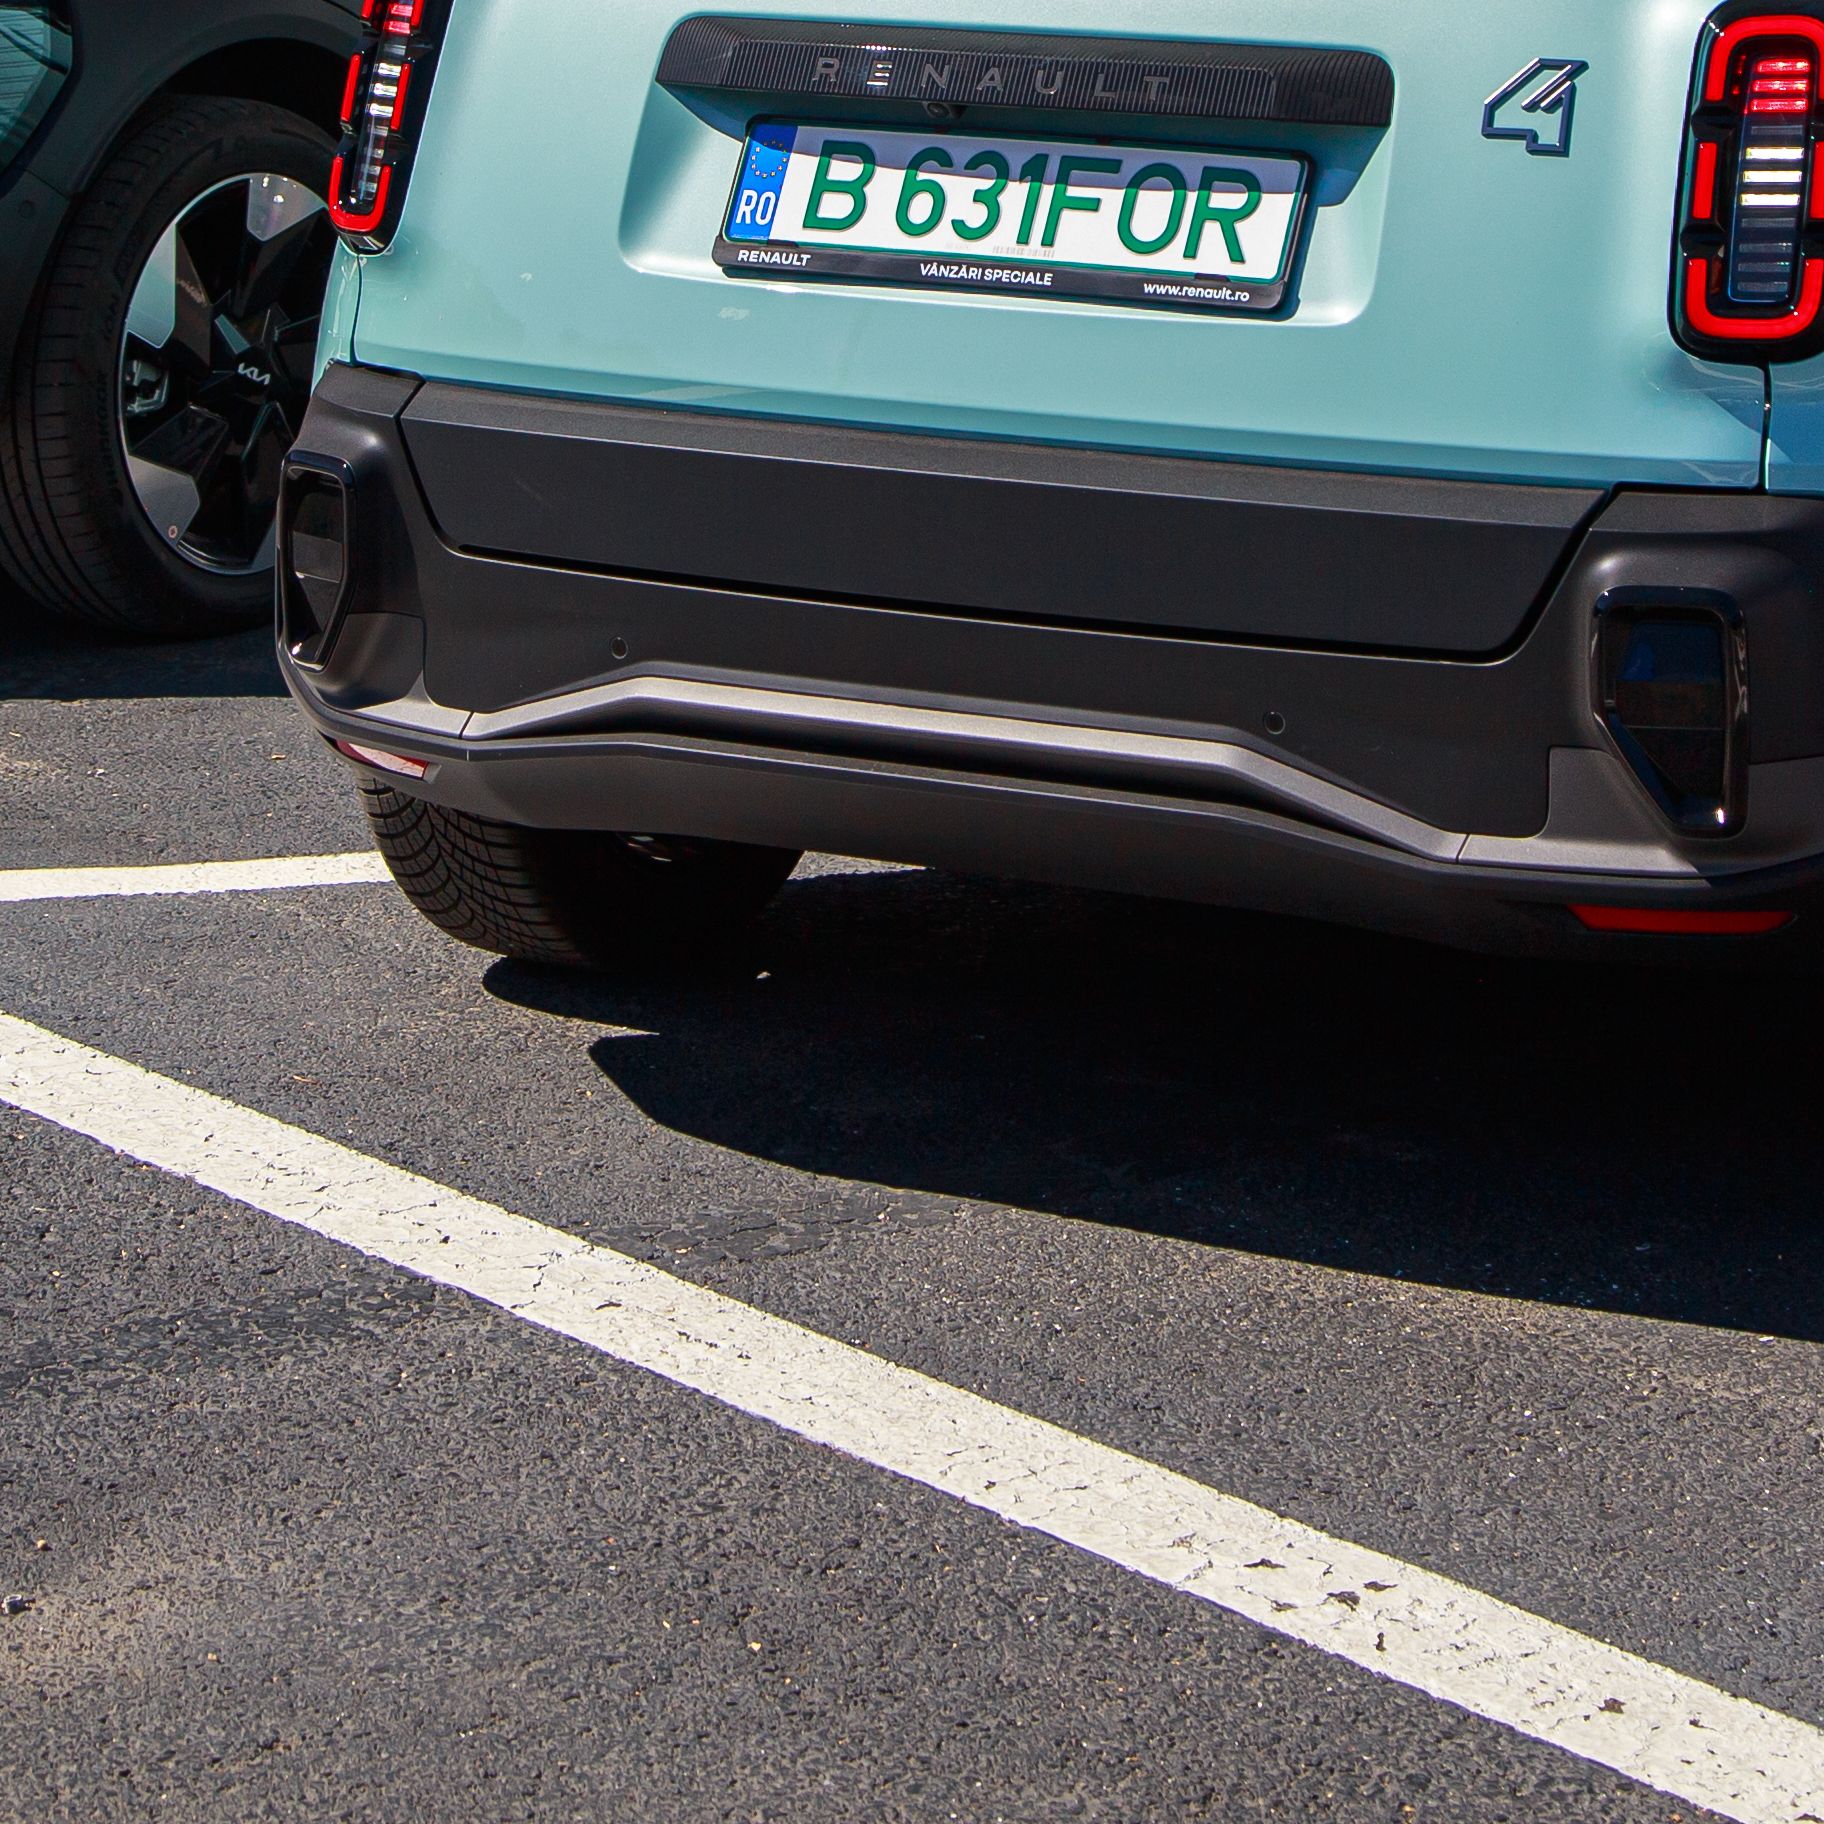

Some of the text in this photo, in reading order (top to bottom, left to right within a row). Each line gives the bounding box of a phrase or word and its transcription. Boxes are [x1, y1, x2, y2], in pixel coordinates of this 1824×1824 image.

[812, 56, 1170, 102] RENAULT
[736, 189, 776, 226] RO
[802, 139, 876, 232] B
[738, 249, 811, 268] RENAULT
[919, 259, 1053, 287] VÂNZĂRI SPECIALE
[1143, 281, 1250, 303] www.renault.ro
